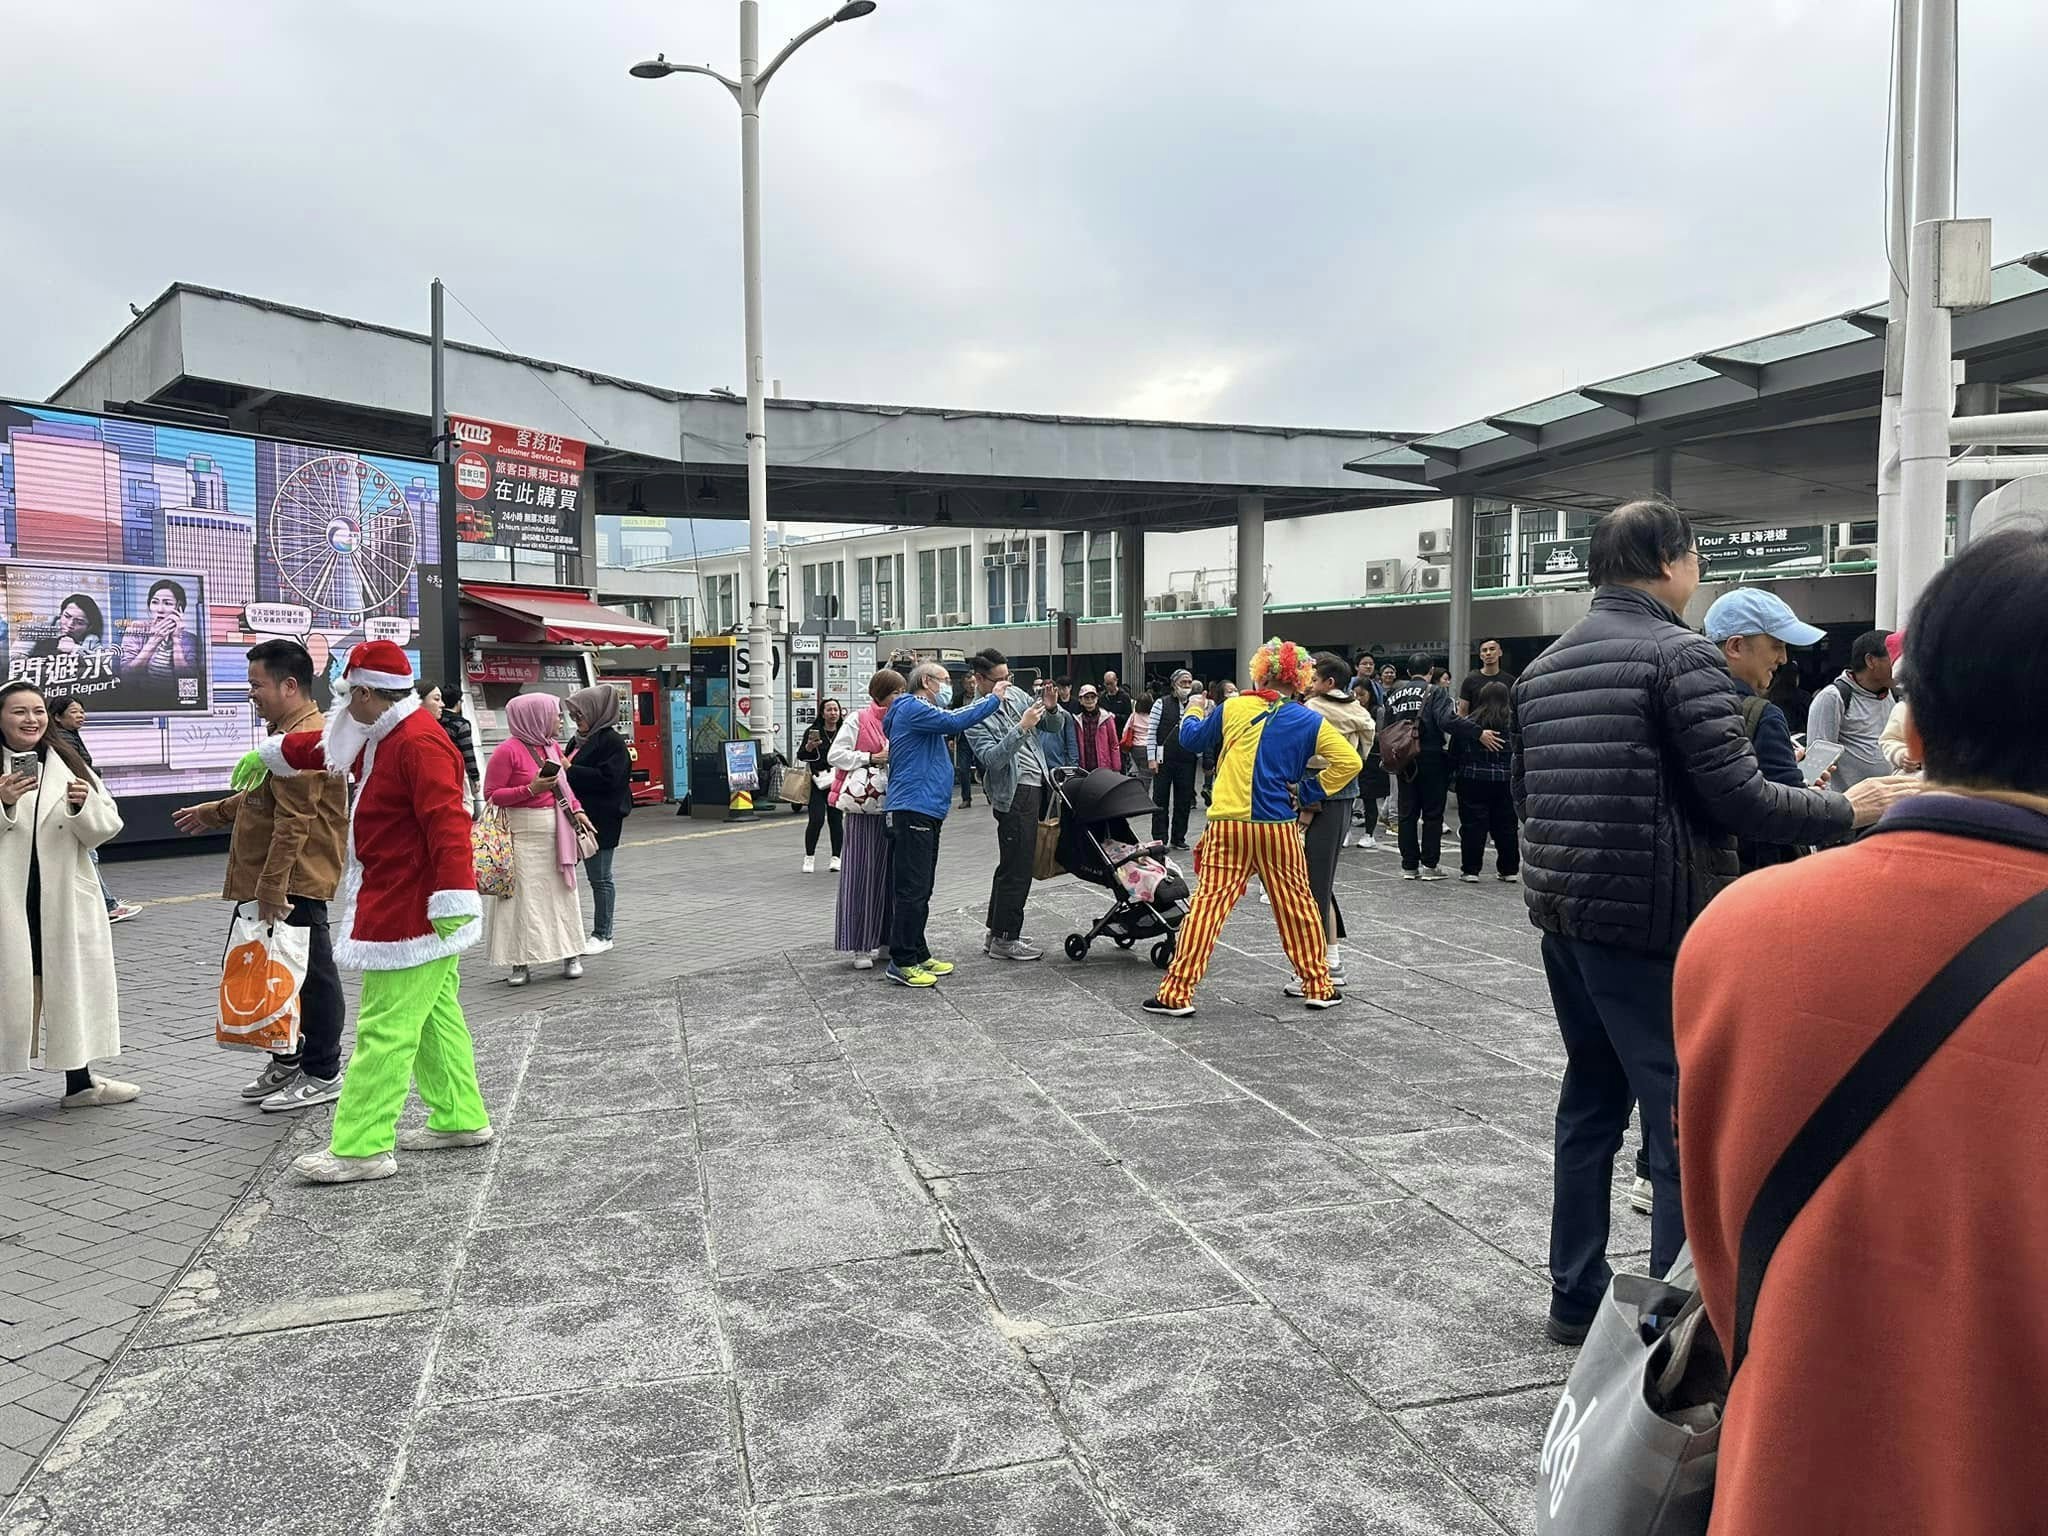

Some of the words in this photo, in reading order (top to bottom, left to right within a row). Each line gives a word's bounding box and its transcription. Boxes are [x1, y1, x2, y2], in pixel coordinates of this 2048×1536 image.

[453, 421, 492, 446] KMB
[516, 429, 562, 454] 客務站
[497, 444, 530, 458] Customer
[531, 451, 555, 463] Service
[555, 456, 577, 467] Centre
[494, 479, 578, 511] 在此購買
[1697, 536, 1724, 546] Tour
[1728, 529, 1788, 544] 天星海港遊
[828, 649, 849, 659] KMB
[857, 646, 873, 665] SF
[70, 680, 117, 696] Report
